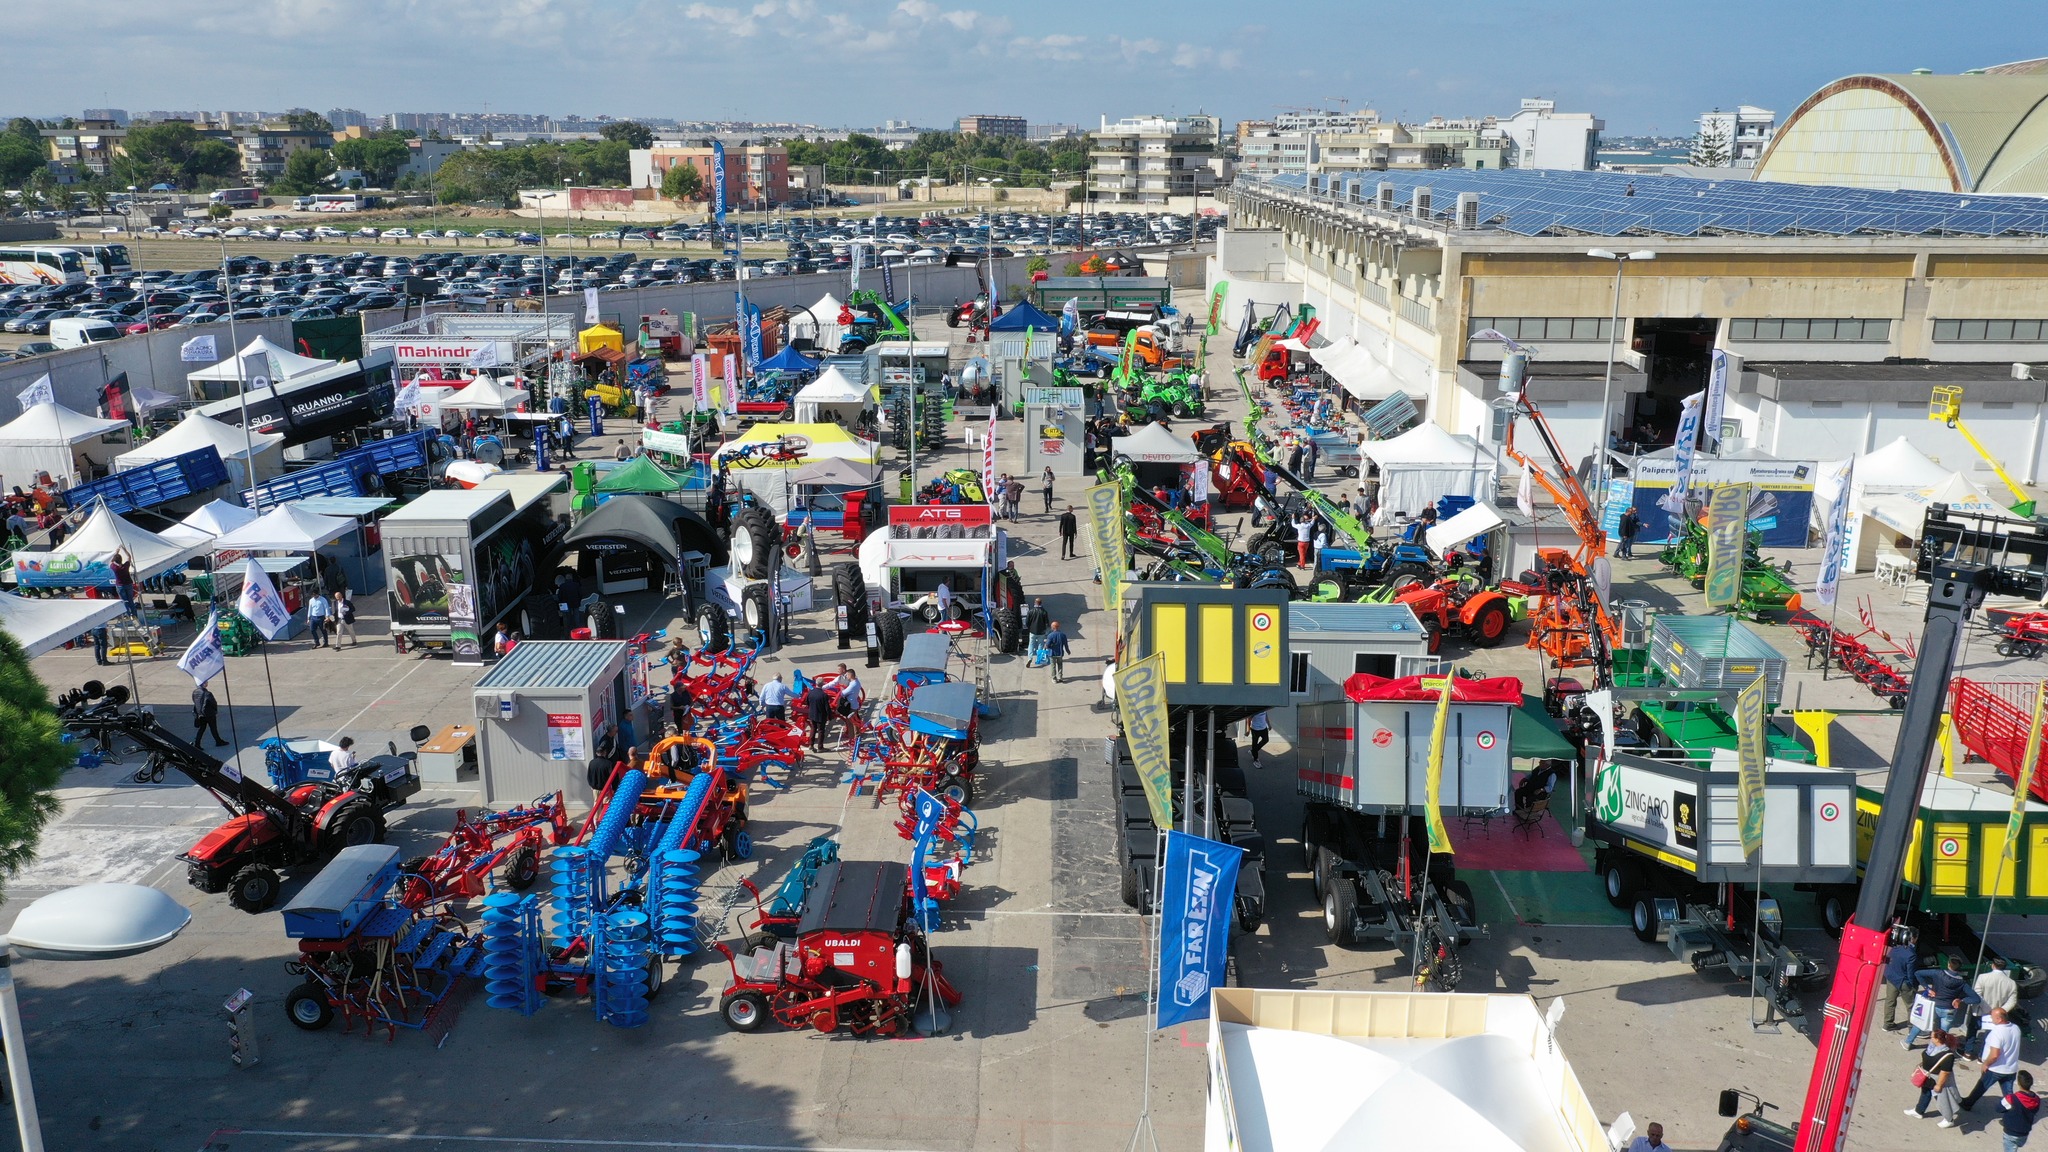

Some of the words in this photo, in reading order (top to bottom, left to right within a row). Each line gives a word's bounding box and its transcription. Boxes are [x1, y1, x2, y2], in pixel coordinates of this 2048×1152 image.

[291, 393, 343, 415] ARUANNO
[251, 414, 272, 426] SUD
[1142, 453, 1171, 461] DEVITO
[919, 509, 962, 518] ATG
[1840, 525, 1853, 568] SAVE
[609, 566, 642, 575] VREDESTEIN
[260, 601, 281, 627] PALMA
[1625, 789, 1669, 819] ZINGARO
[1185, 867, 1214, 966] FARESIN
[825, 939, 861, 947] UBALDI
